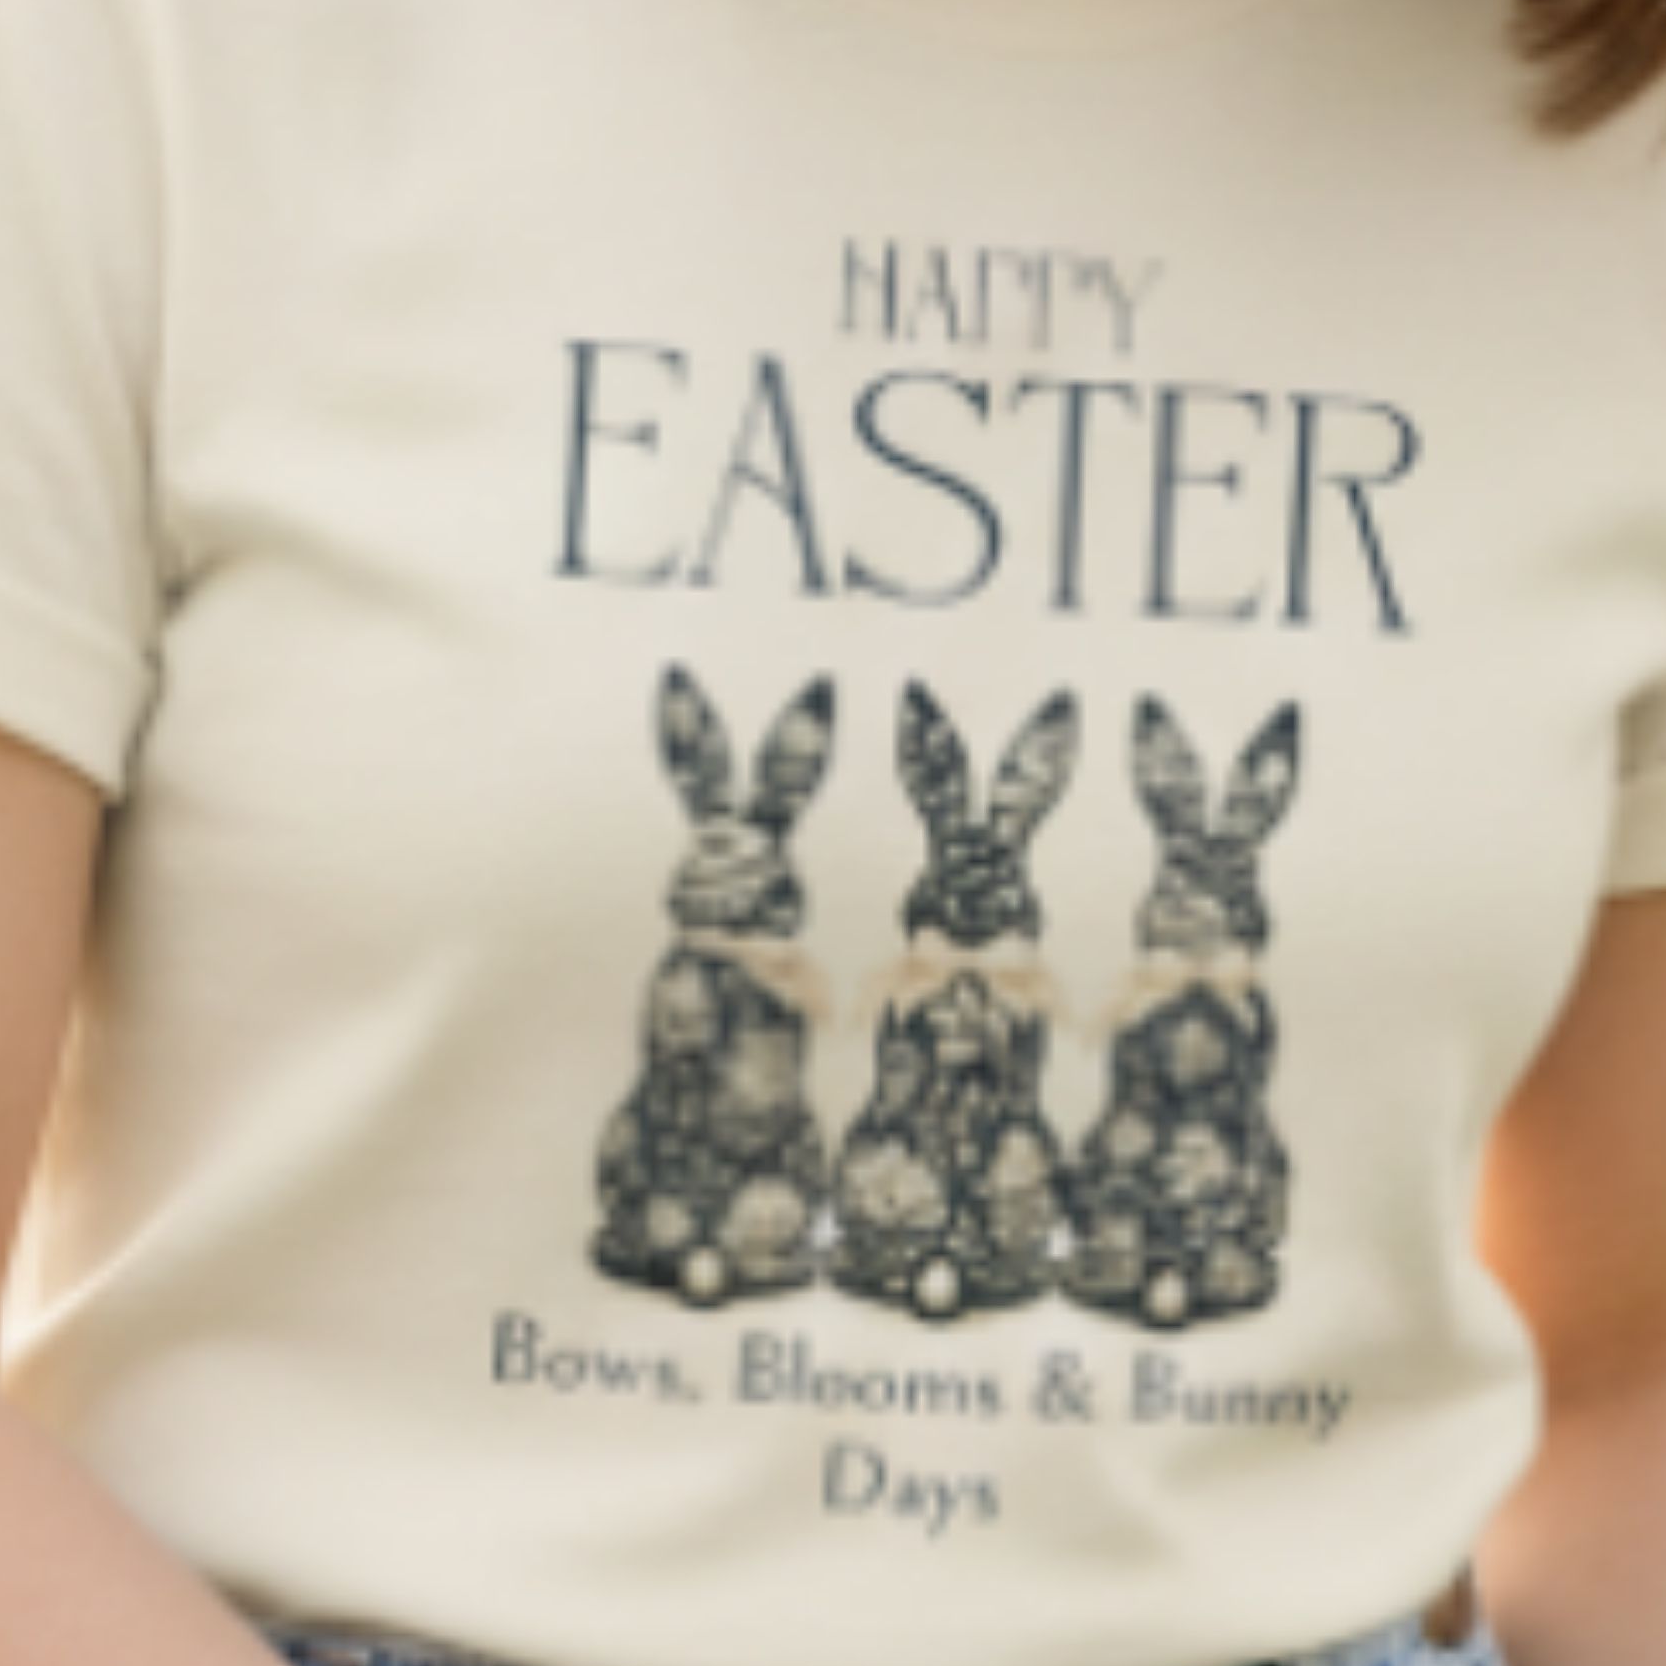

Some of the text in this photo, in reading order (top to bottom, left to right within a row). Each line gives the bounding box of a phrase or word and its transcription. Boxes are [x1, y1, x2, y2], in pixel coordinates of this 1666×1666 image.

[839, 238, 1161, 353] HAPPY
[553, 337, 1423, 636] EASTER
[731, 1326, 1005, 1419] Blooms
[1031, 1352, 1095, 1422] &
[1131, 1358, 1353, 1442] Bunny
[820, 1441, 1002, 1538] Days
